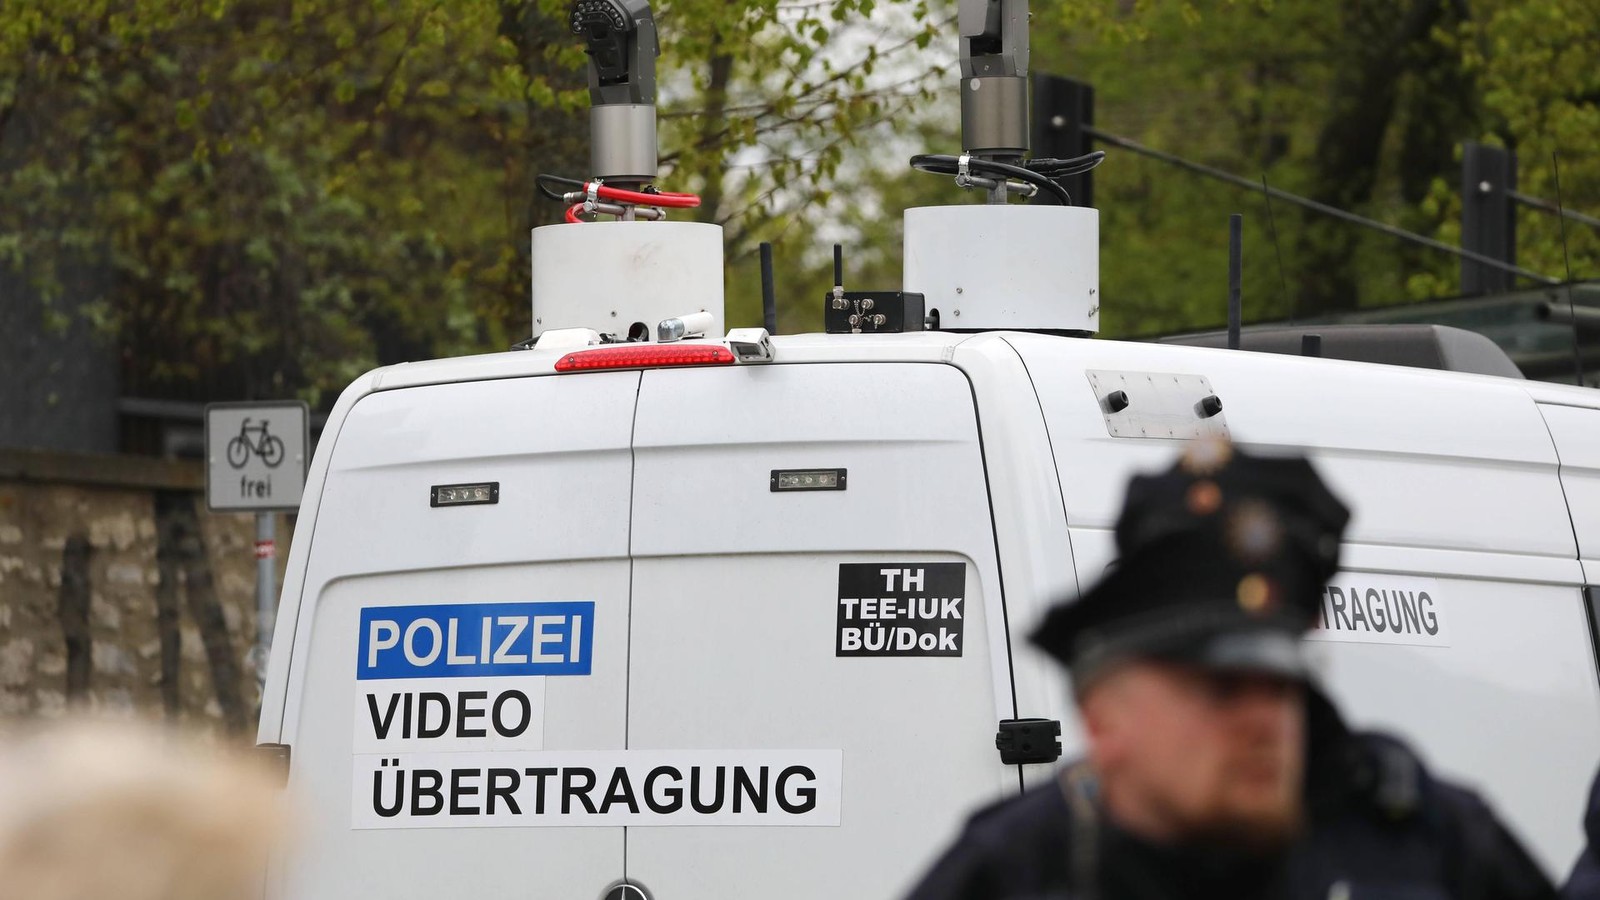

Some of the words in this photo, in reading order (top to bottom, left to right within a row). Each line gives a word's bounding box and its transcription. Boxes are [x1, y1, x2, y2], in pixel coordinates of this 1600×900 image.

[240, 475, 272, 498] frei
[880, 568, 925, 592] TH
[840, 597, 962, 620] TEE-IUK
[1312, 586, 1439, 636] TRAGUNG
[367, 614, 582, 668] POLIZEI
[841, 622, 958, 651] BÜ/Dok
[366, 689, 532, 740] VIDEO
[373, 758, 817, 817] ÜBERTRAGUNG
